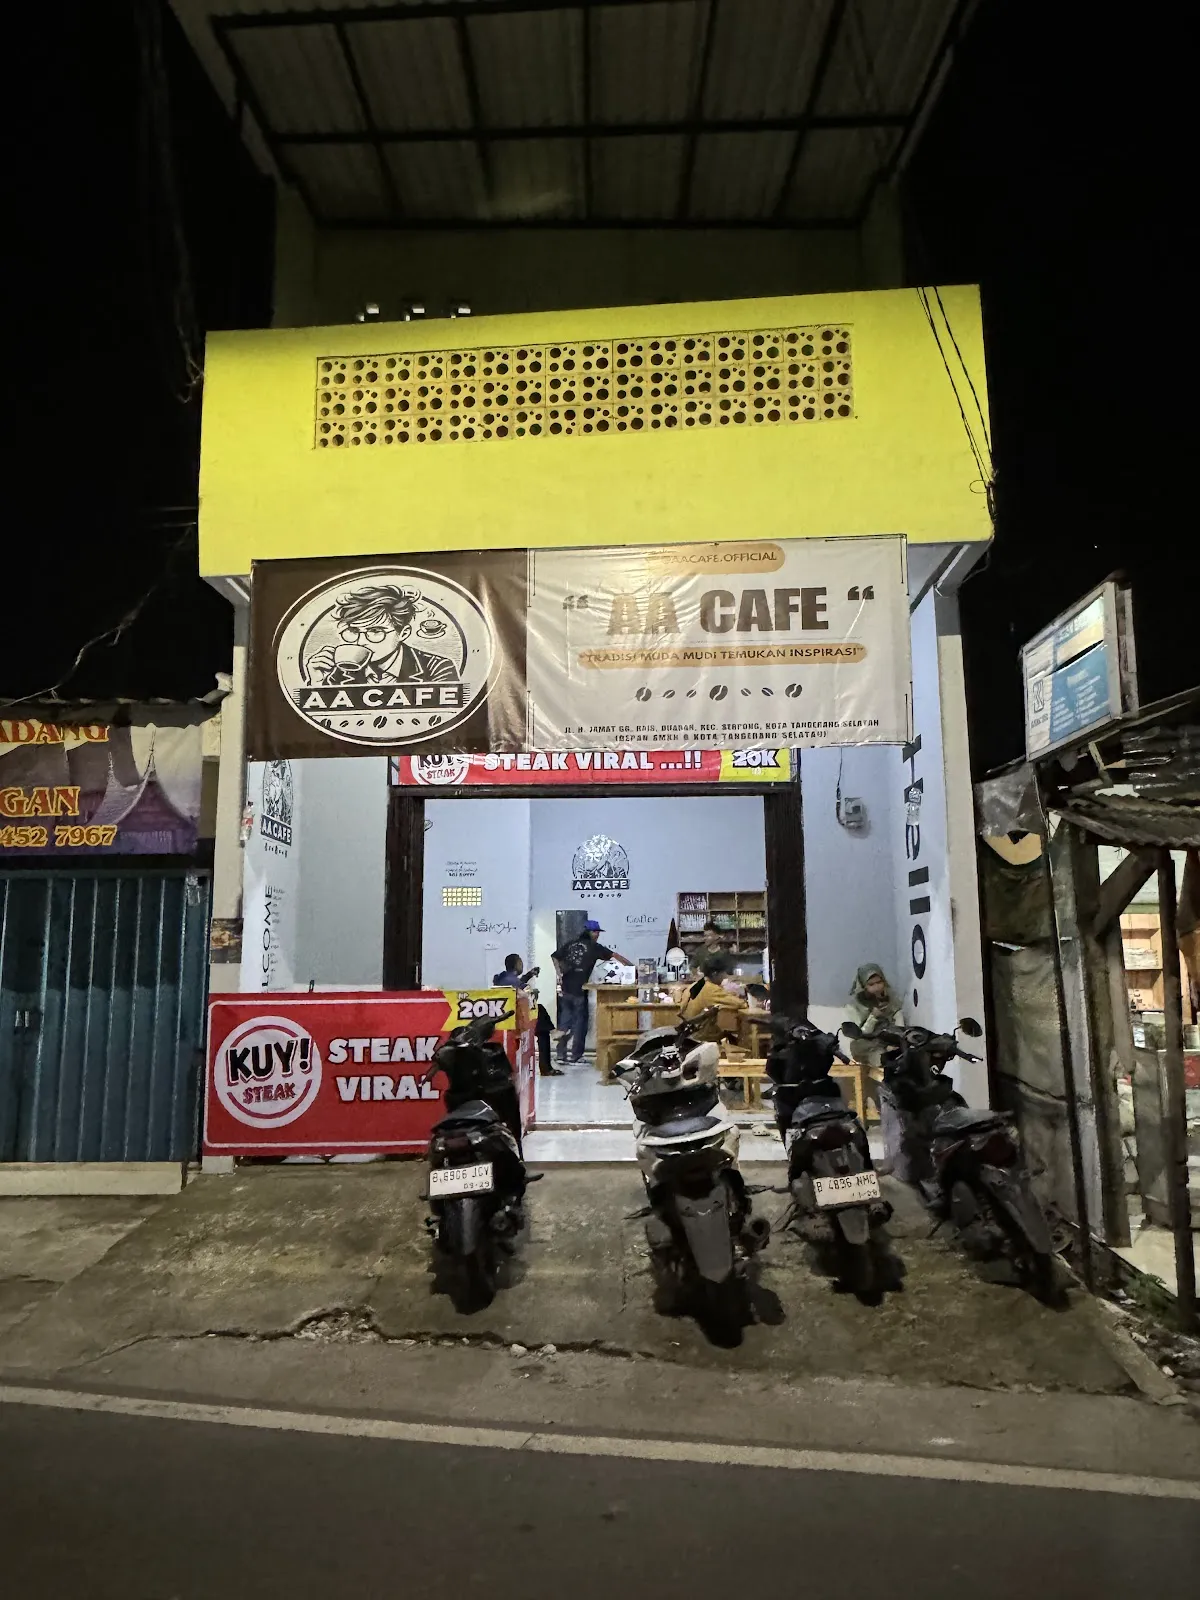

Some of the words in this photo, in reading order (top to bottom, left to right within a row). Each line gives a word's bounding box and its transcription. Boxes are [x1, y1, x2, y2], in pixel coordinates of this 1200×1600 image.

[606, 593, 682, 635] AA
[700, 586, 828, 634] CAFE
[641, 652, 680, 661] MUDA
[683, 651, 717, 660] MUDI
[720, 649, 786, 660] TEMUKAN
[303, 691, 355, 709] AA
[362, 686, 459, 707] CAFE
[693, 733, 718, 741] KOTA
[484, 753, 570, 771] STEAK
[575, 752, 654, 770] VIRAL
[734, 750, 778, 767] 20K
[55, 825, 117, 846] 7967
[273, 823, 291, 843] CAFE
[574, 880, 592, 890] AA
[594, 880, 628, 889] CAFE
[459, 1000, 506, 1018] 20K
[328, 1037, 440, 1063] STEAK
[226, 1037, 313, 1086] KUY!
[242, 1082, 297, 1104] STEAK
[336, 1075, 440, 1102] VIRAL
[816, 1181, 823, 1192] B
